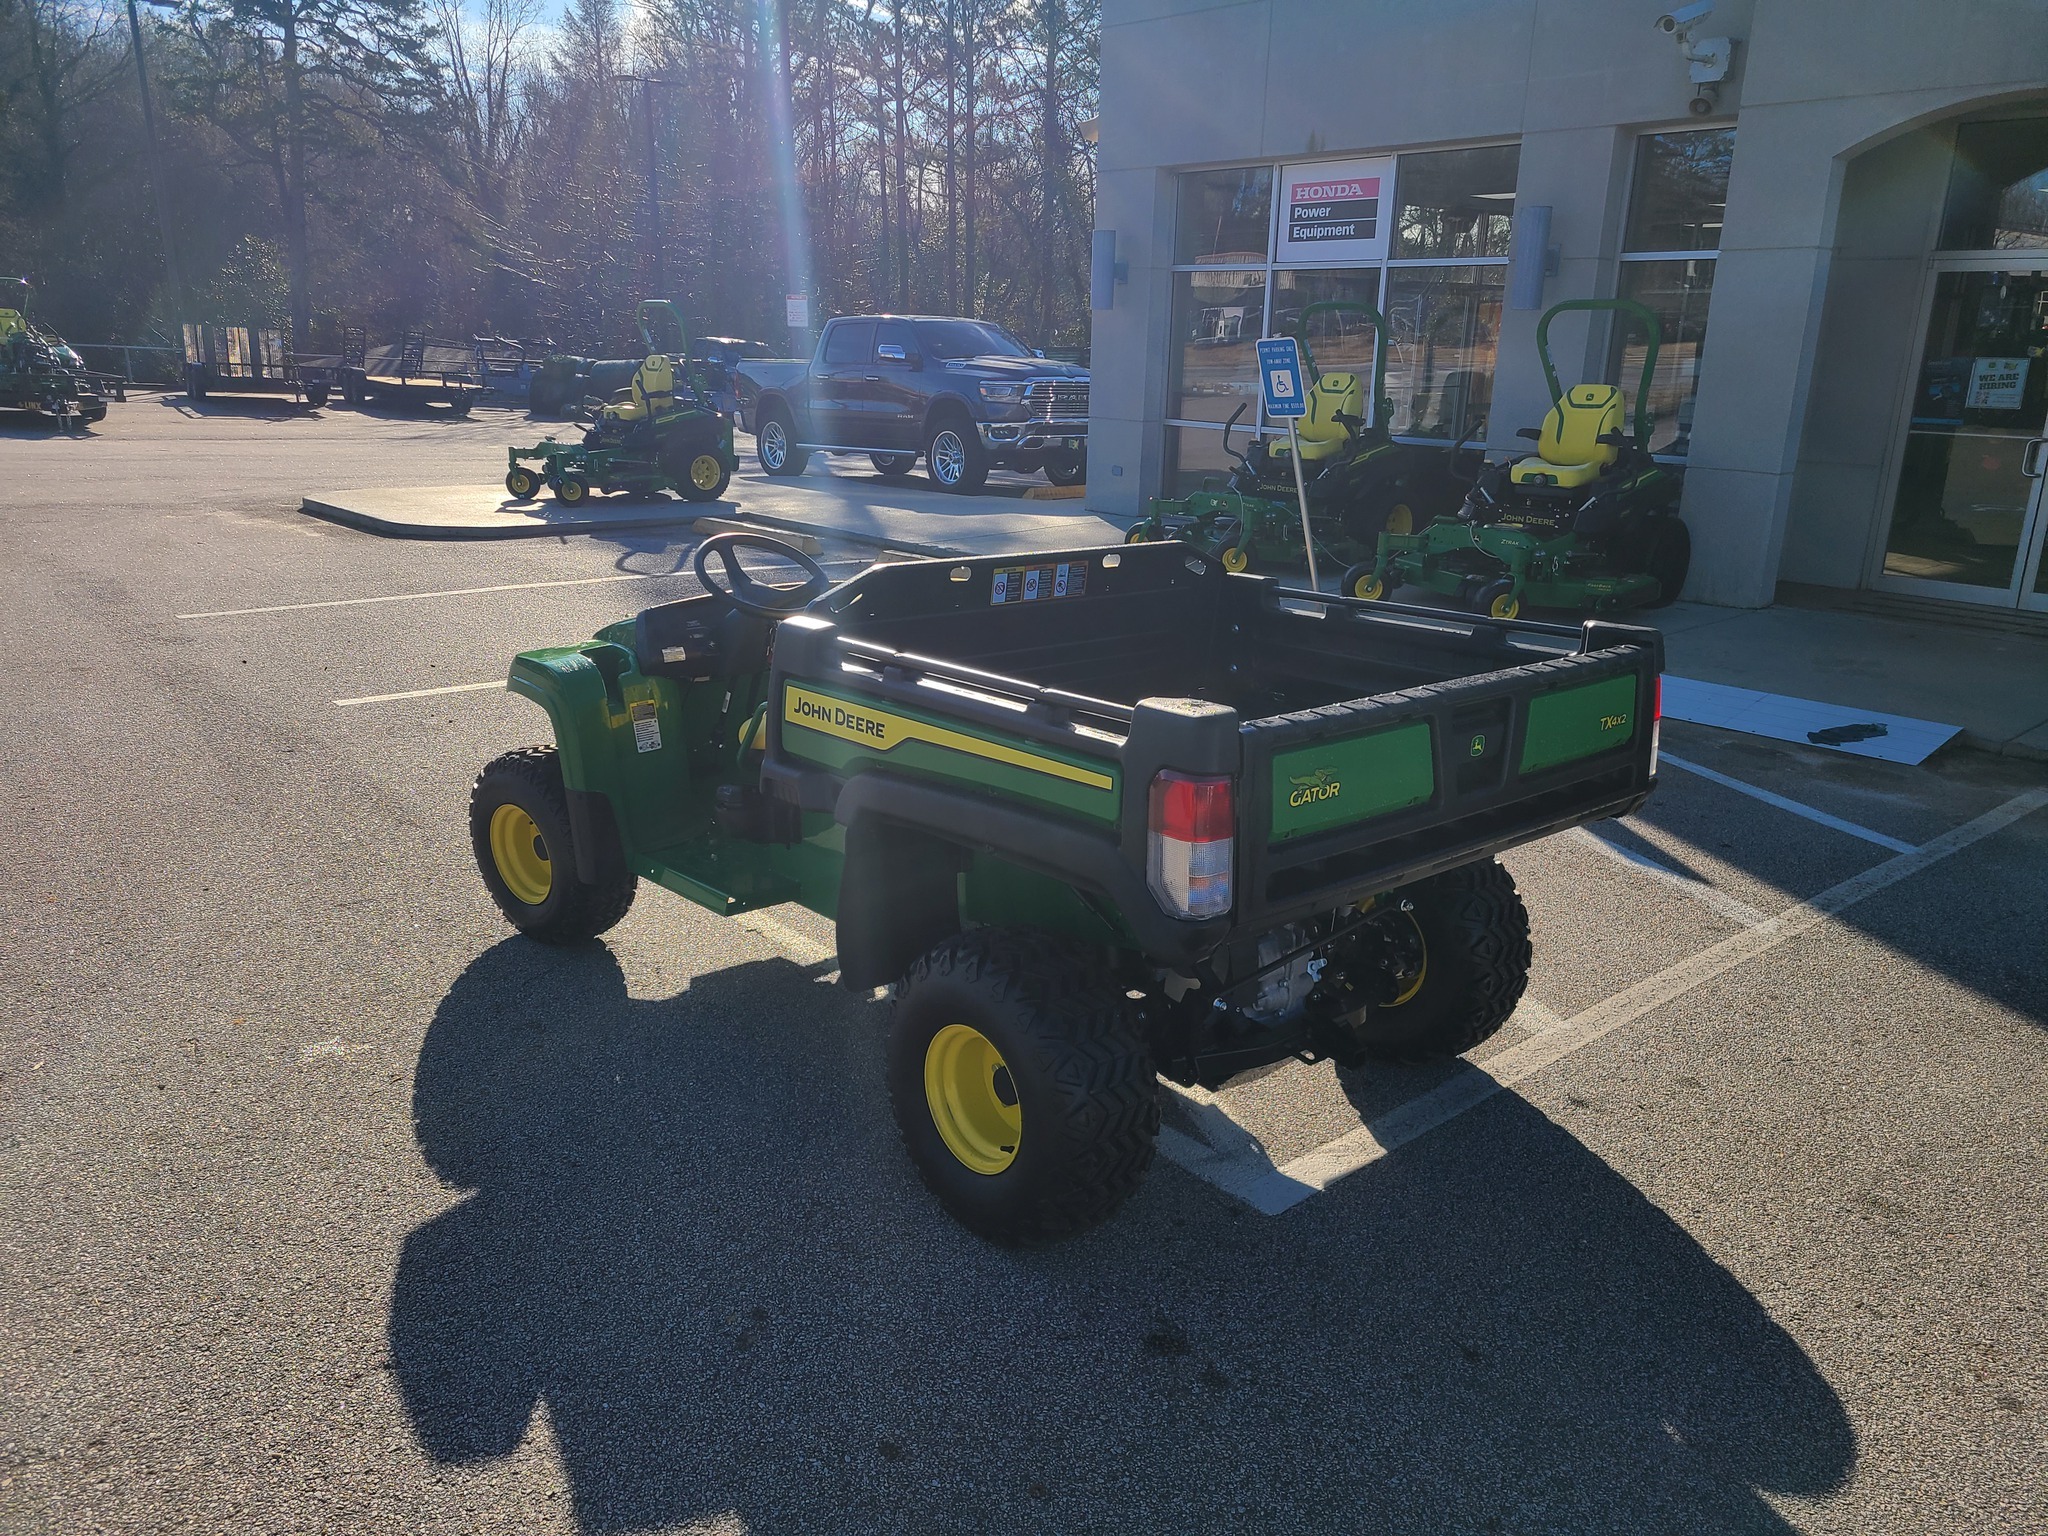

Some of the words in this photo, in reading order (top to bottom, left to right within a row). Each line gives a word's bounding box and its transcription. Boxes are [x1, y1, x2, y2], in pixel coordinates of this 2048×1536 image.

[1295, 183, 1363, 200] HONDA
[1294, 206, 1331, 219] Power
[1293, 223, 1355, 240] Equipment
[1979, 374, 1996, 382] WE
[1998, 373, 2020, 381] ARE
[1979, 381, 2017, 390] HIRING
[1260, 483, 1276, 491] JOHN
[1501, 513, 1525, 523] JOHN
[1525, 515, 1556, 527] DEERE
[794, 697, 832, 723] JOHN
[835, 707, 885, 739] DEERE
[1289, 782, 1340, 807] GATOR
